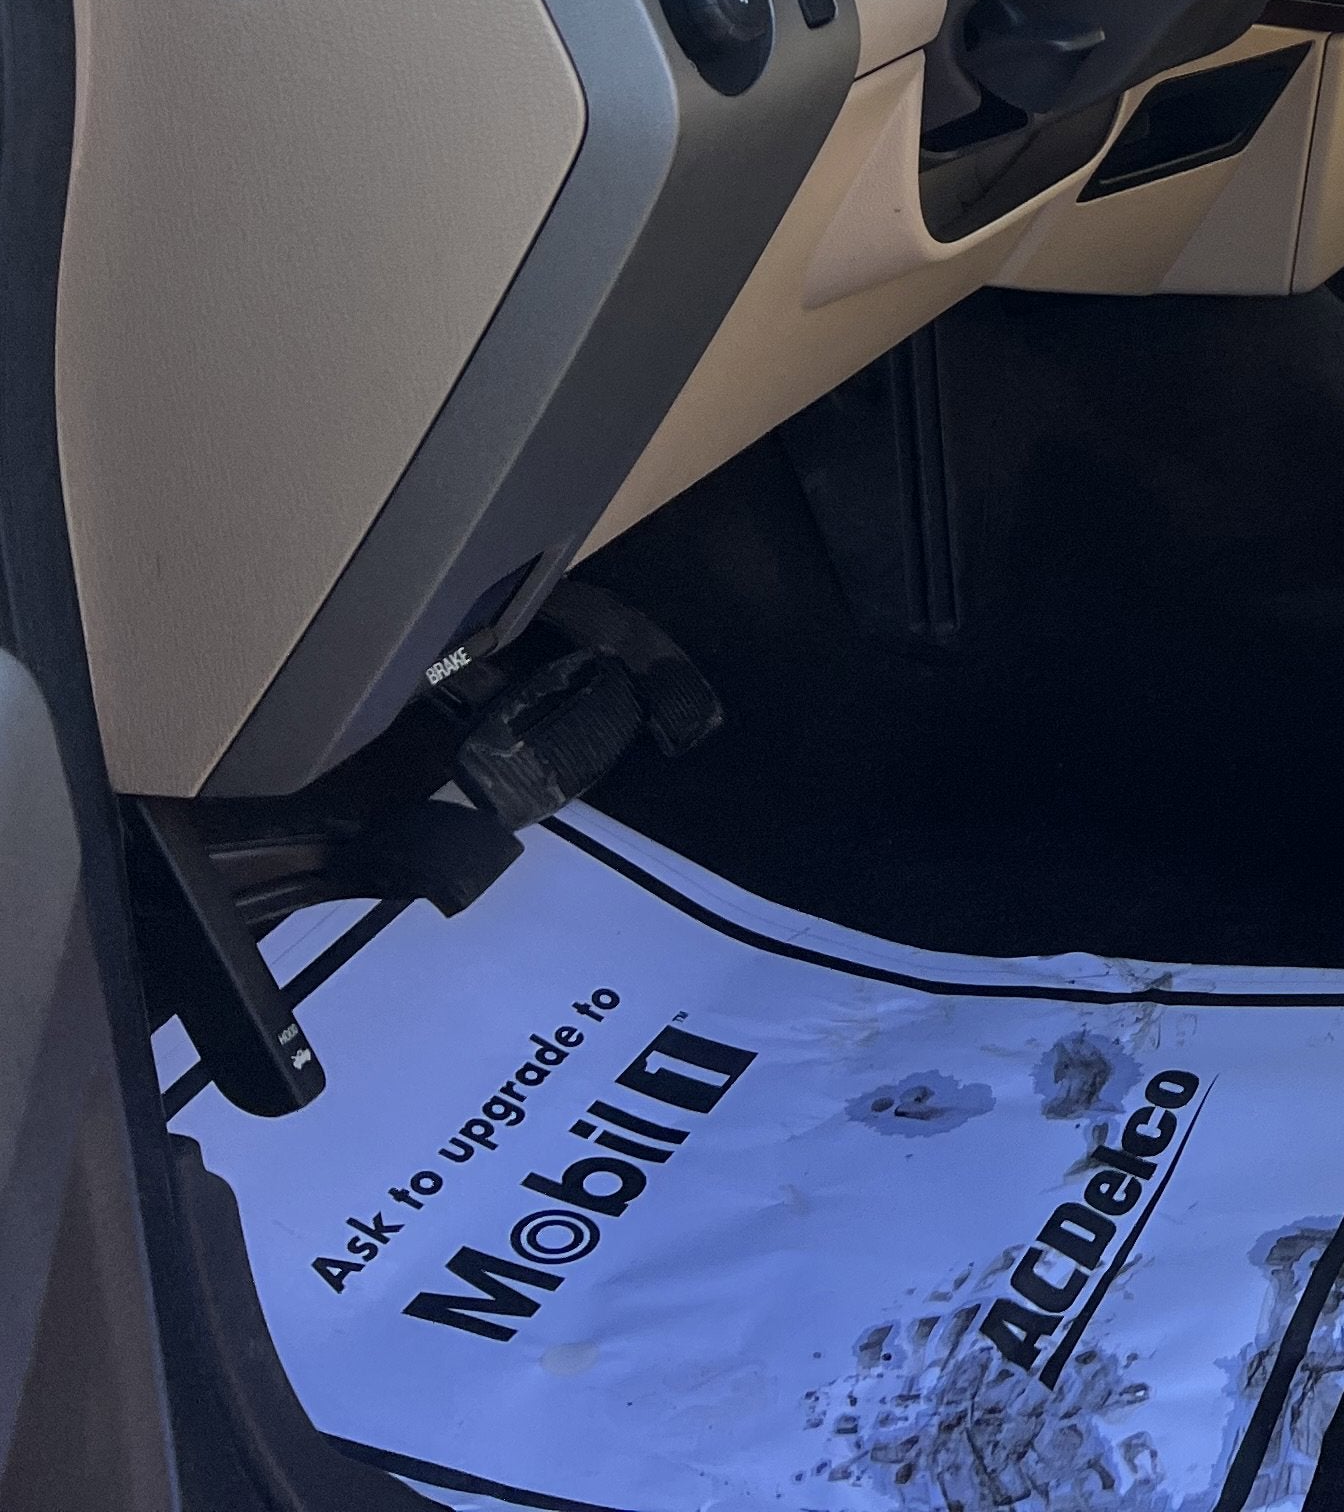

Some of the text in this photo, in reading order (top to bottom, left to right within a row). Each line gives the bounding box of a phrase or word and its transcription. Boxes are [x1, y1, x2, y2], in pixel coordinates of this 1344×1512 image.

[425, 646, 471, 686] BRAKE
[278, 1023, 299, 1046] HOOD
[311, 988, 621, 1294] Ask to upgrade to
[401, 1100, 691, 1342] Mobil
[978, 1069, 1200, 1372] ACDelco
